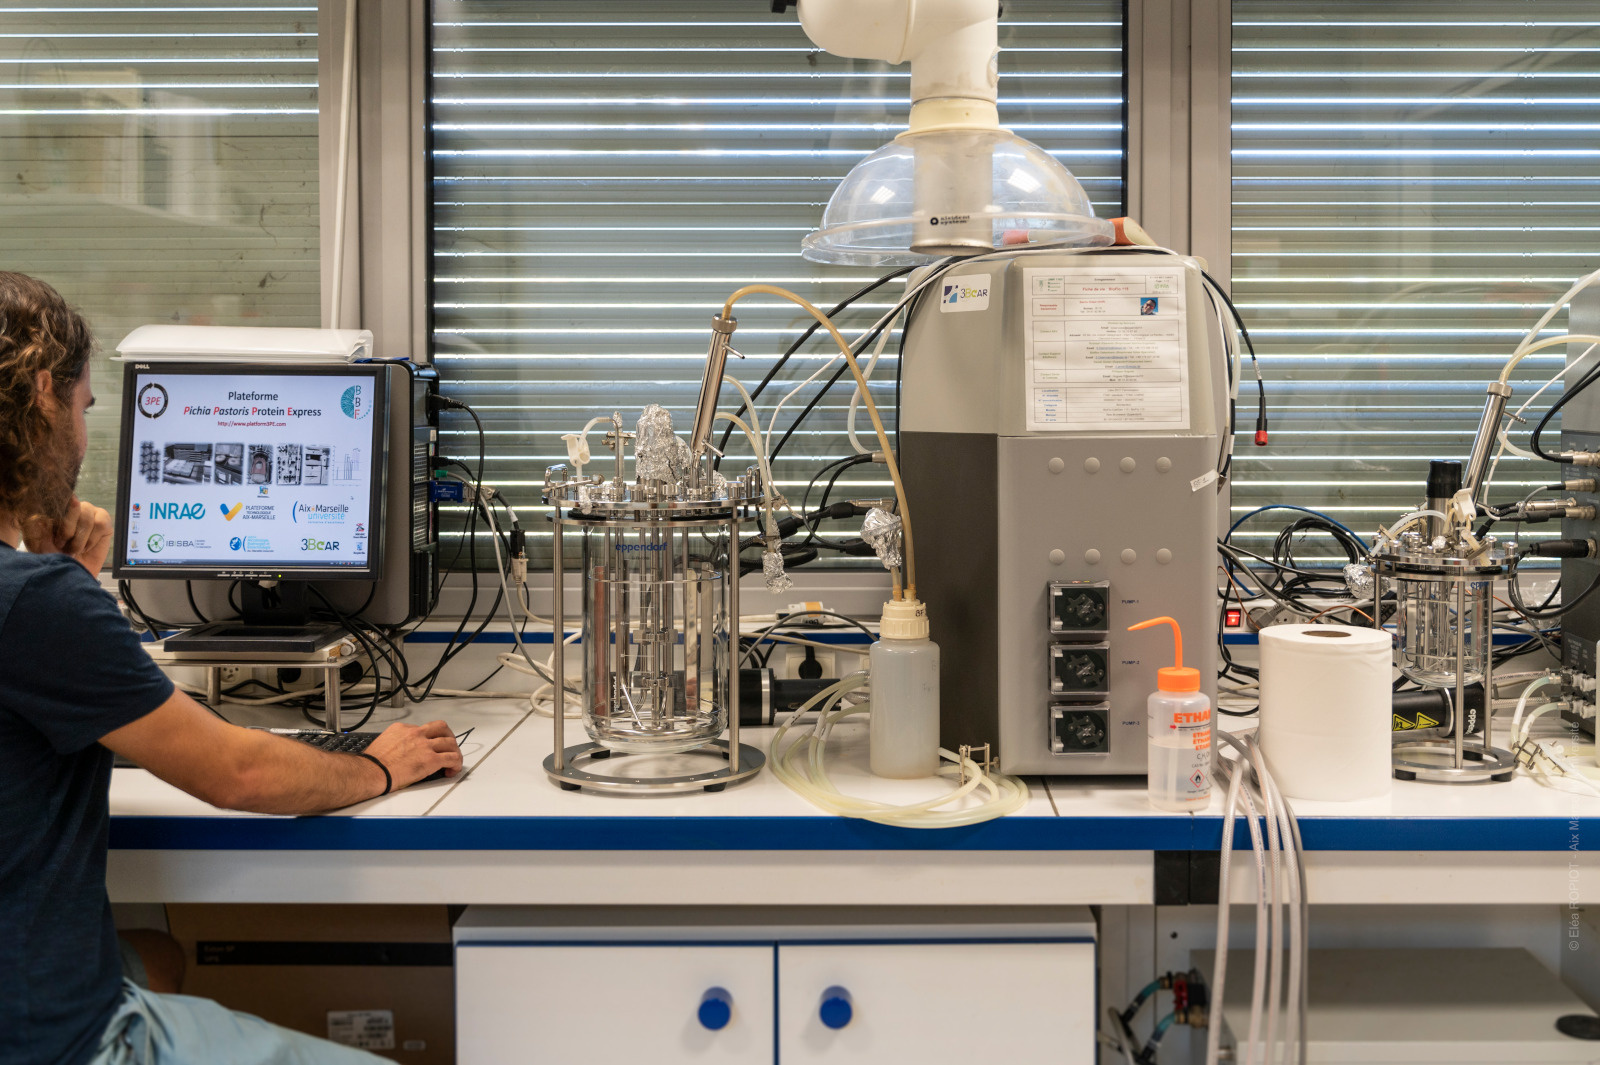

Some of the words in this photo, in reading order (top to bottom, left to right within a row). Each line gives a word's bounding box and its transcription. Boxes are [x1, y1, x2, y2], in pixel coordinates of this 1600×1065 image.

[145, 396, 161, 406] 3PE
[228, 391, 279, 401] Plateforme
[184, 406, 211, 416] Pichia
[213, 406, 249, 416] Pastoris
[251, 406, 285, 416] Protein
[287, 407, 322, 418] Express
[307, 512, 345, 520] université
[615, 542, 668, 552] eppendorf
